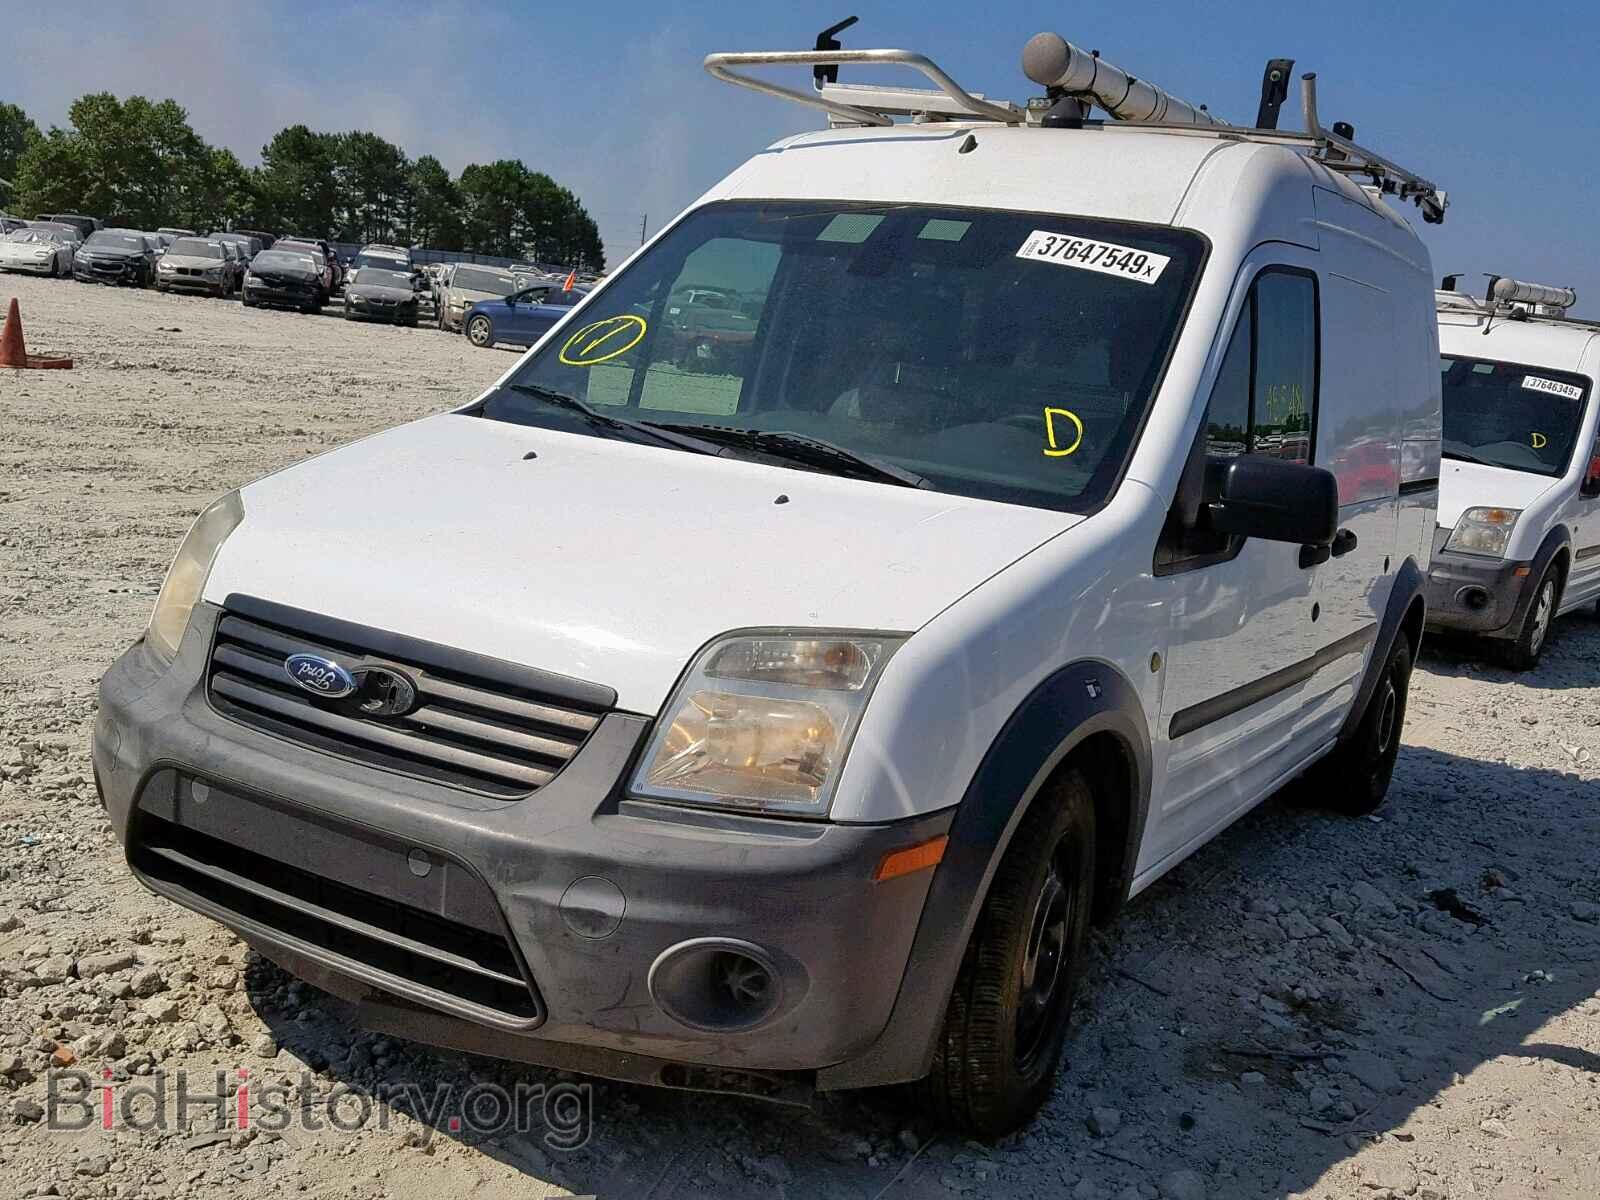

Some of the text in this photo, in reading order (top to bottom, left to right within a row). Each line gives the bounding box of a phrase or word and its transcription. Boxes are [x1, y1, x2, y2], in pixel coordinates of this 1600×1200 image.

[1044, 407, 1083, 456] D
[1531, 432, 1547, 448] D
[297, 662, 336, 690] Ford
